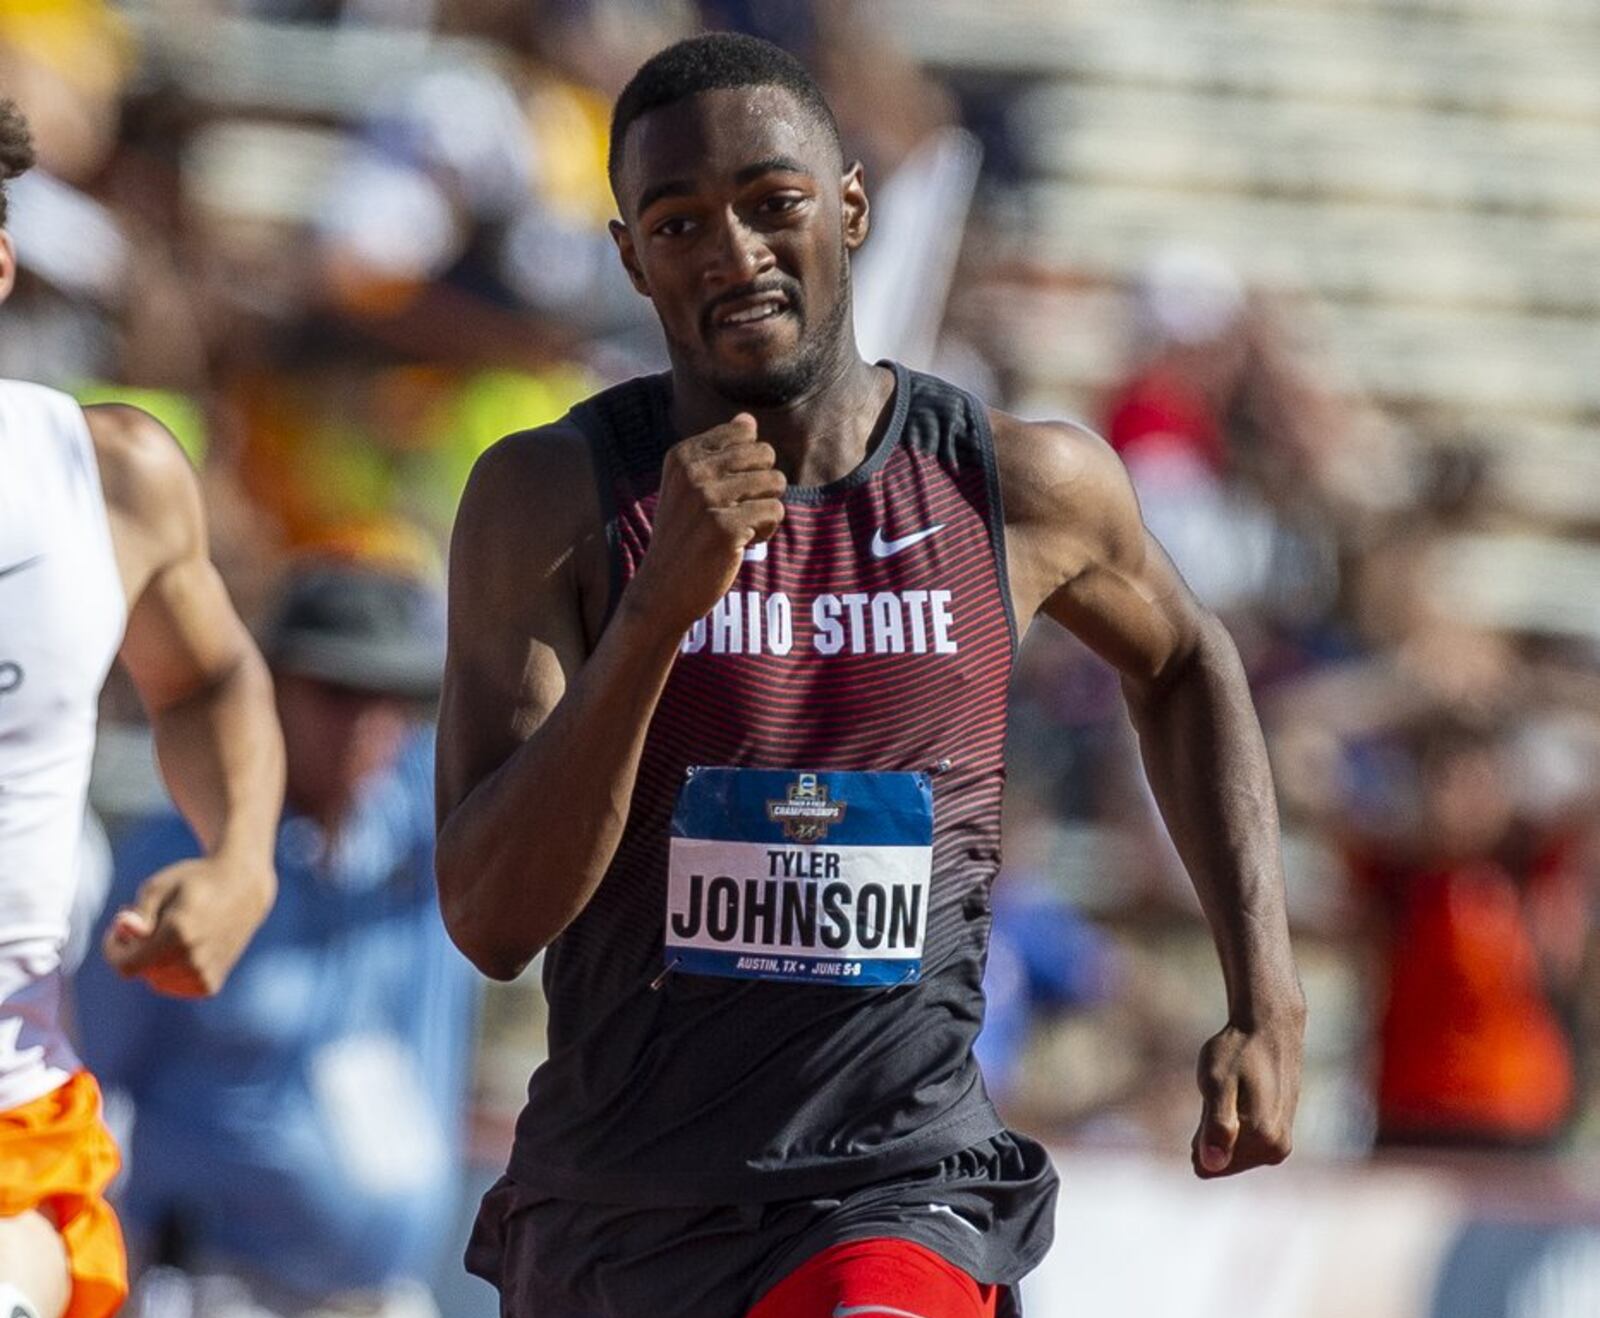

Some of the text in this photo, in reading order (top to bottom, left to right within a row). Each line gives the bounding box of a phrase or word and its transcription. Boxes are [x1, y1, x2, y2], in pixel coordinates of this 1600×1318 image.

[812, 590, 957, 655] STATE
[767, 850, 840, 878] TYLER
[671, 875, 922, 950] JOHNSON
[736, 957, 780, 972] AUSTIN,
[783, 960, 797, 973] TX
[811, 962, 841, 975] JUNE
